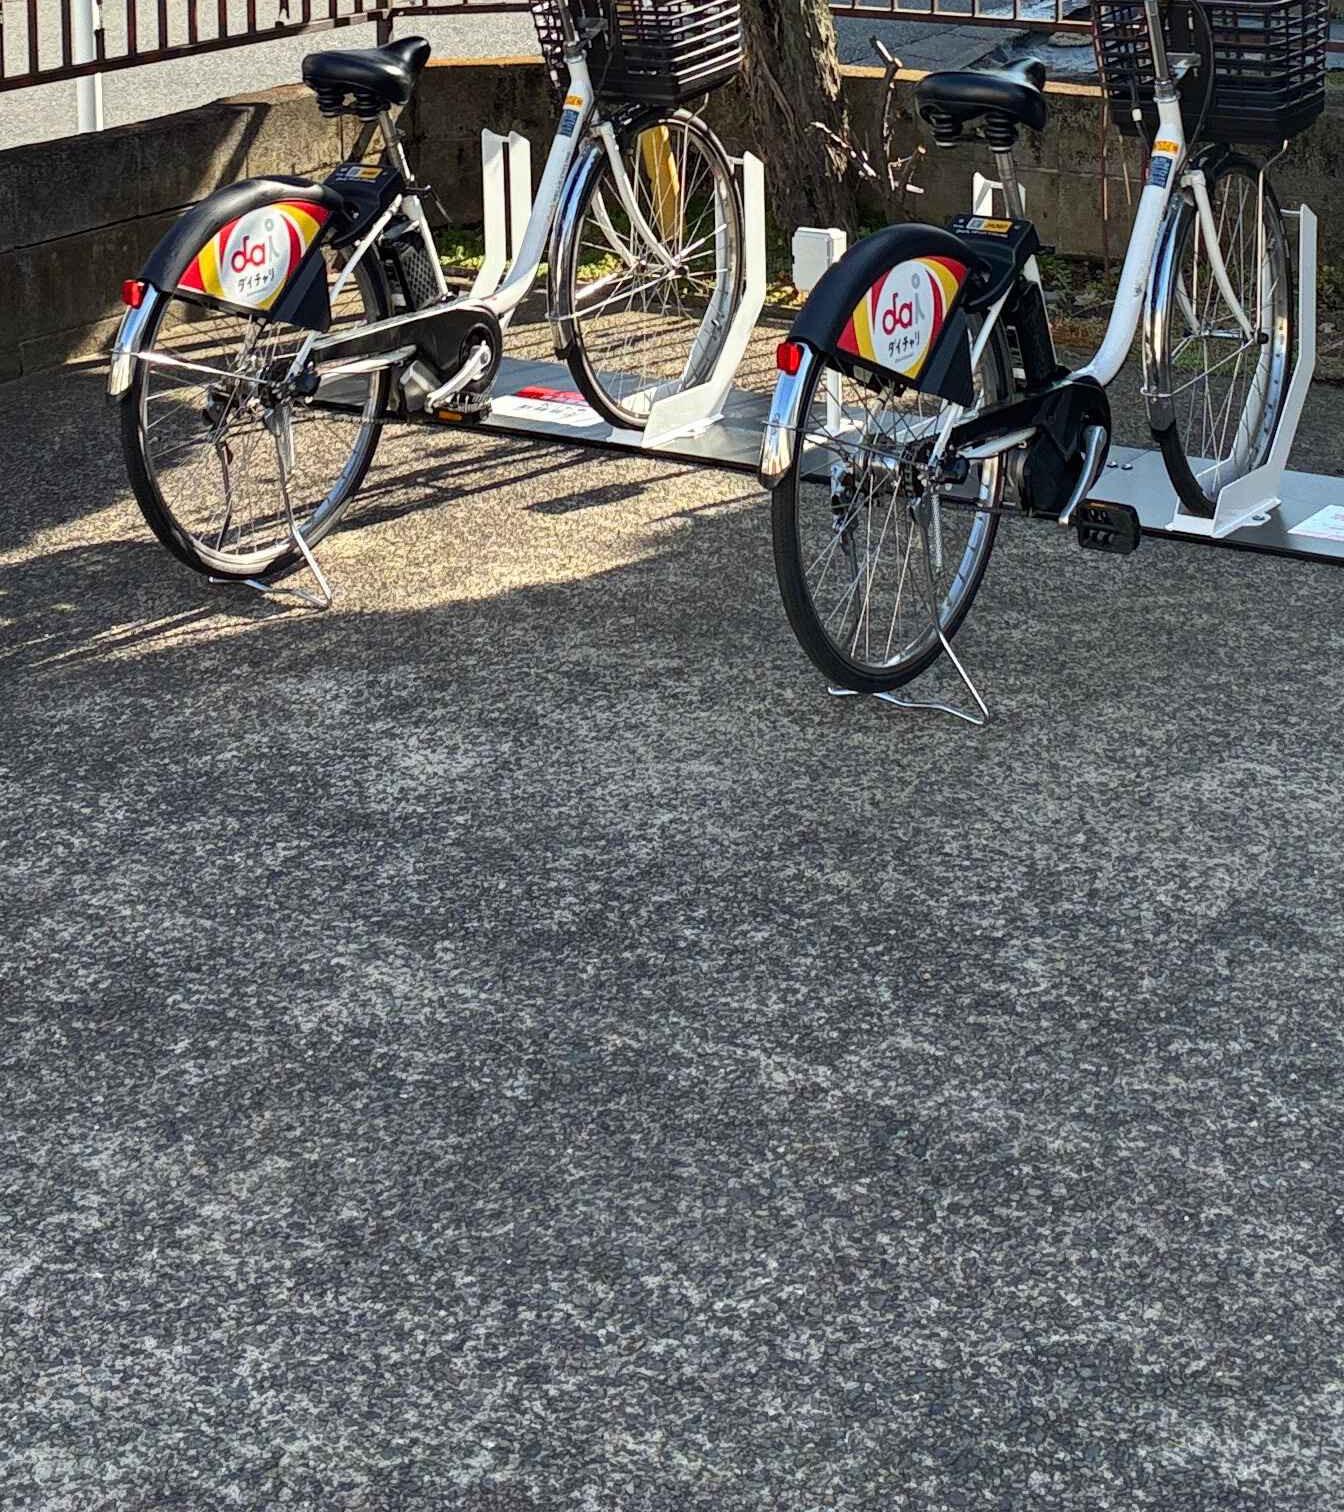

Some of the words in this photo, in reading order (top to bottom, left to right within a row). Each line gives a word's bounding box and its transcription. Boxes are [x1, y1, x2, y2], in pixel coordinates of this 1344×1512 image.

[231, 218, 280, 273] dai
[238, 268, 275, 292] ダイチャリ
[882, 273, 925, 335] dai
[888, 330, 920, 357] ダイチャリ
